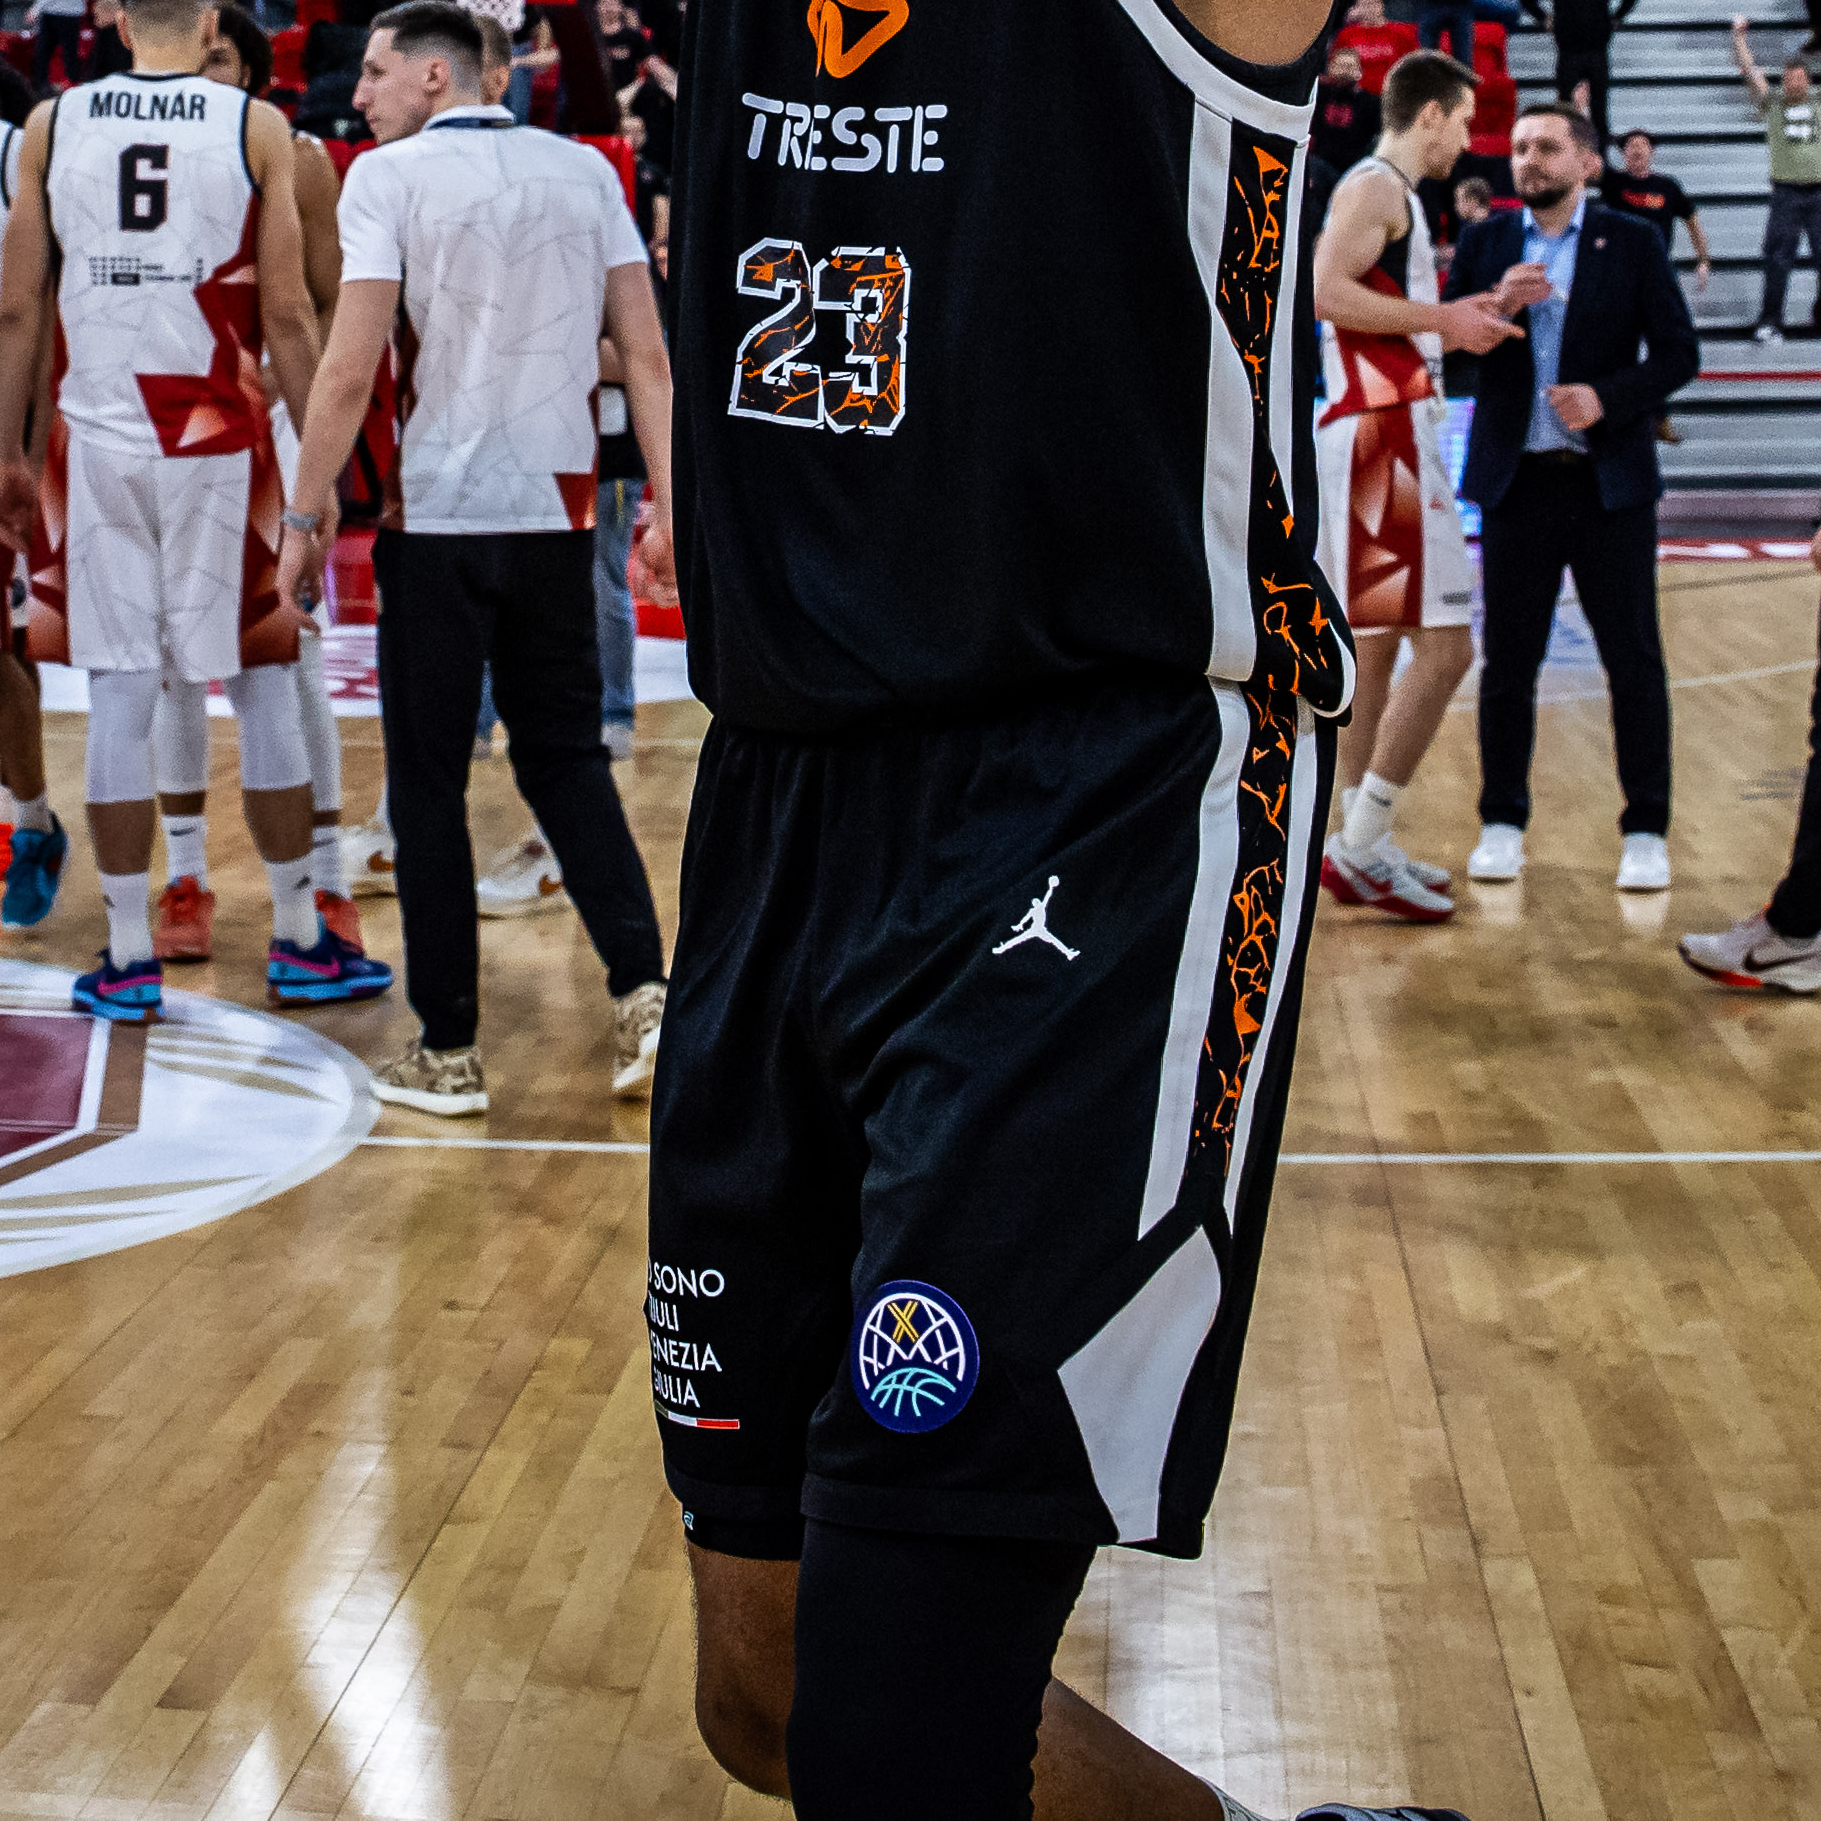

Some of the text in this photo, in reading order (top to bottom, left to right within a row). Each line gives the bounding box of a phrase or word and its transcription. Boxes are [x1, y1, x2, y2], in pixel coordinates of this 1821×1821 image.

[89, 89, 207, 121] MOLNÁR
[118, 143, 169, 232] 6
[727, 236, 912, 437] 23
[653, 1261, 726, 1298] SONO
